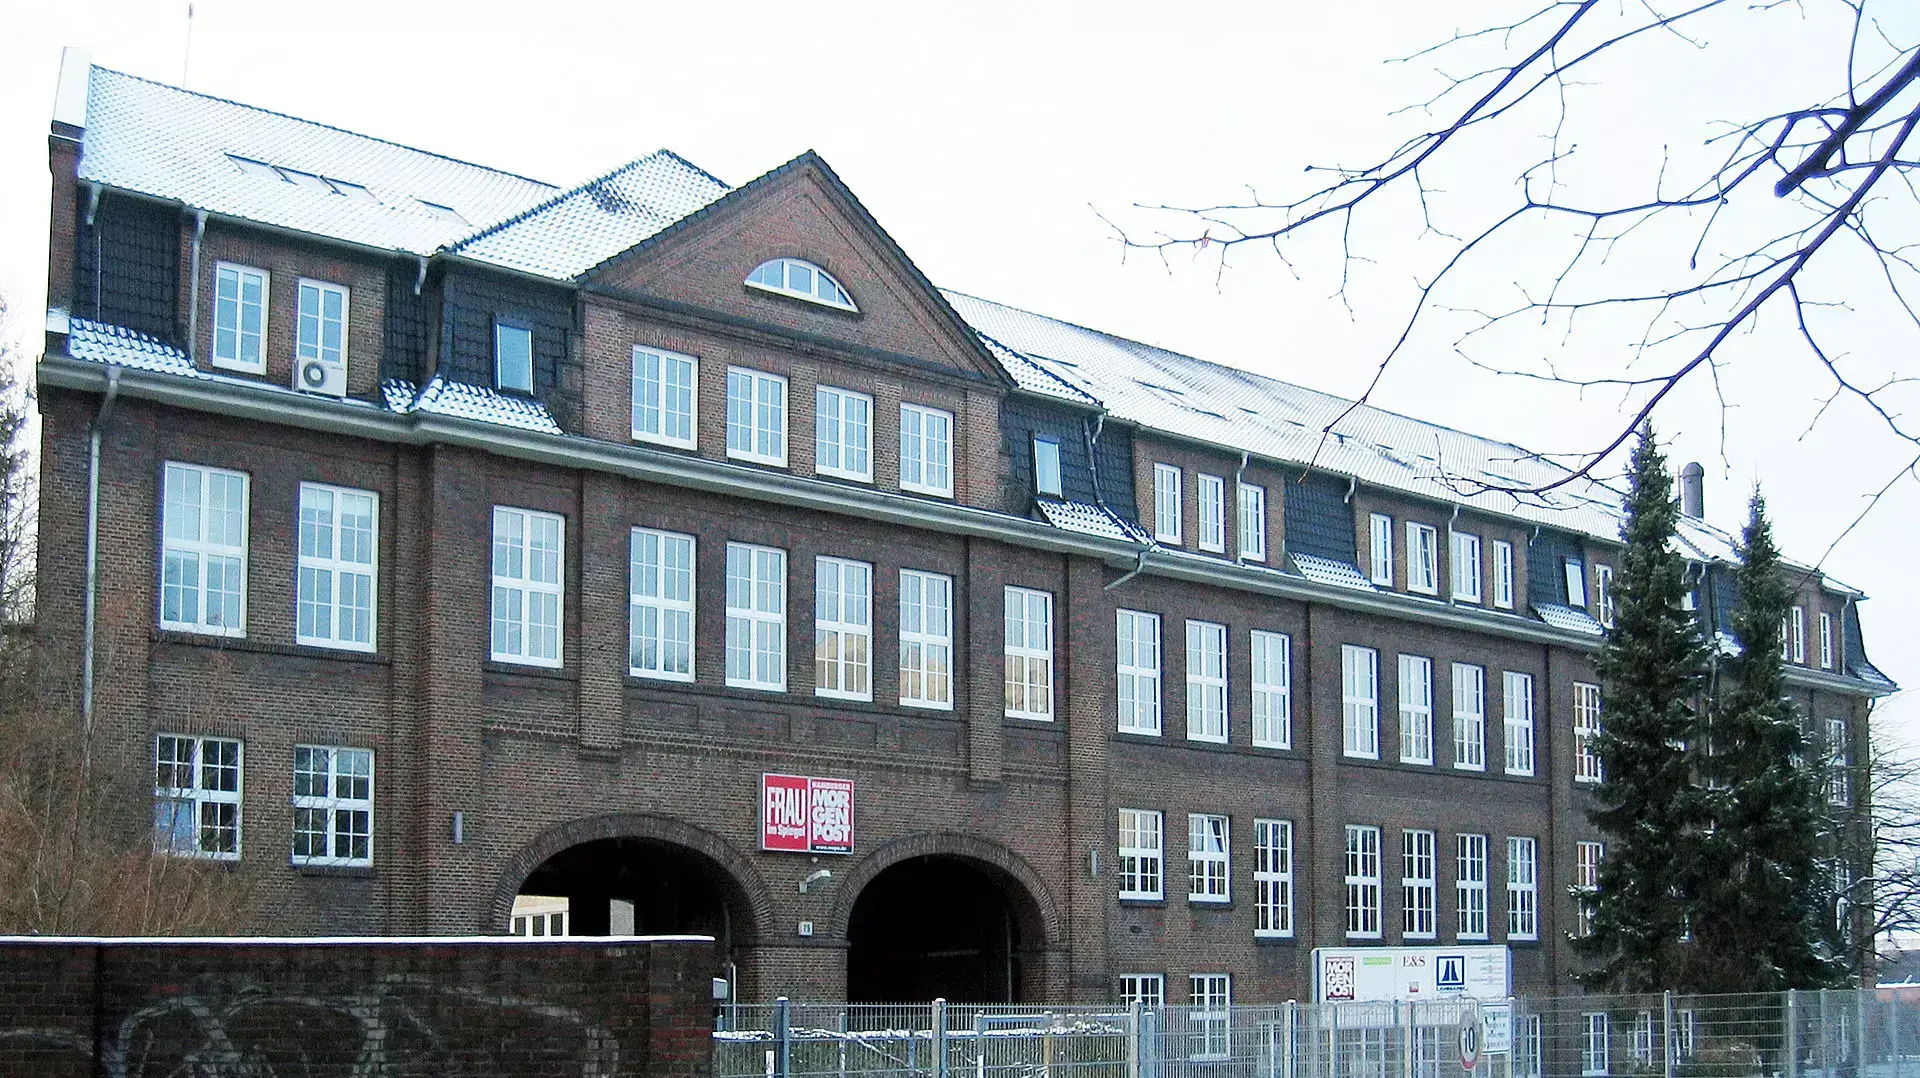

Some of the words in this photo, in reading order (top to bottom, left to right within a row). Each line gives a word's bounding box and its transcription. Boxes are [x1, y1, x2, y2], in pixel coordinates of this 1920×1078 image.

[766, 786, 806, 827] FRAU
[811, 788, 851, 809] MOR
[811, 806, 849, 825] GEN
[812, 822, 851, 843] POST
[1326, 961, 1353, 975] MOR
[1403, 955, 1426, 968] E&S
[1326, 972, 1353, 986] GEN
[1326, 984, 1354, 997] POST
[1463, 1027, 1476, 1053] 10
